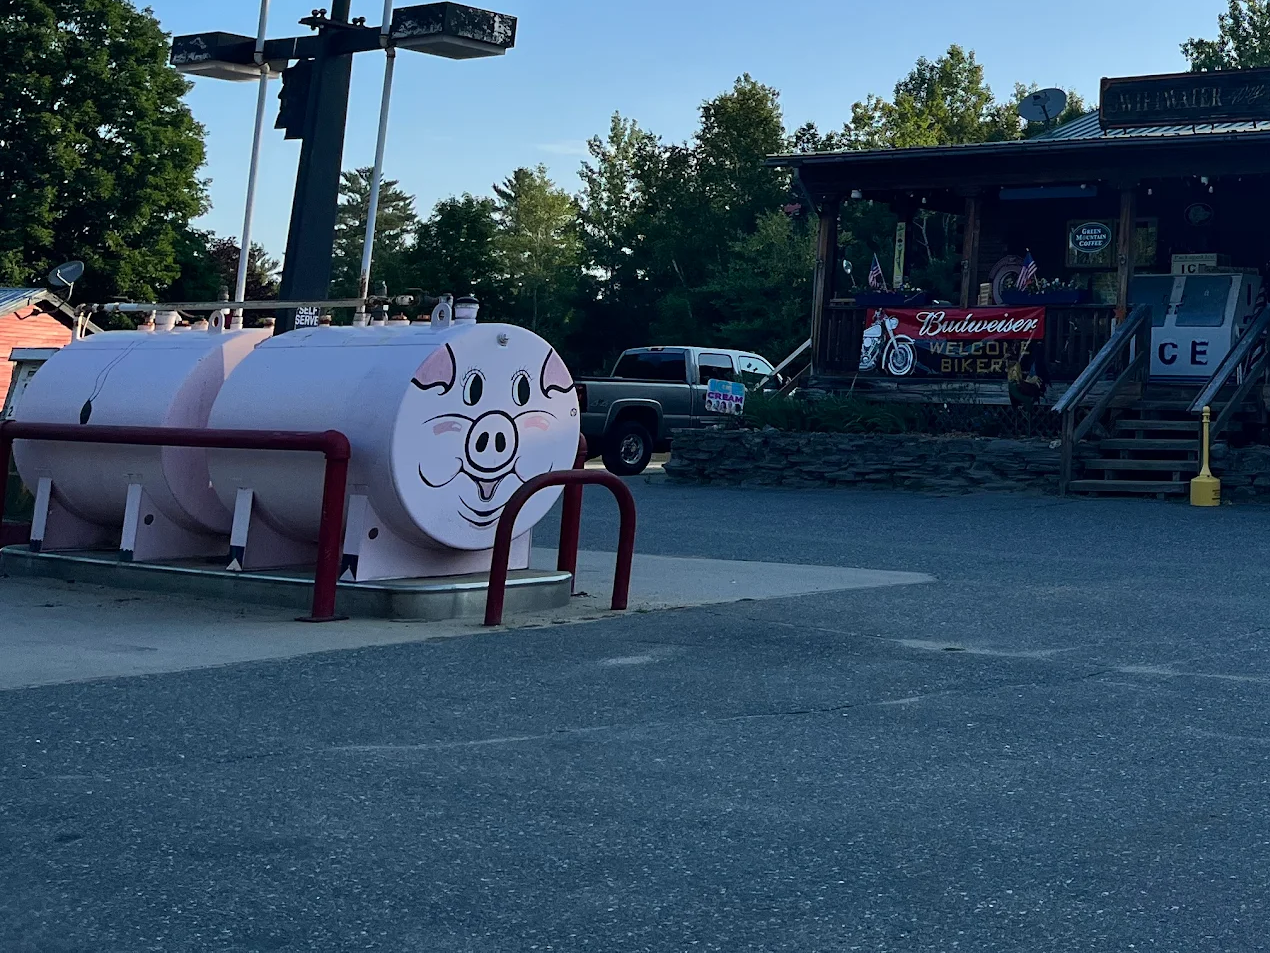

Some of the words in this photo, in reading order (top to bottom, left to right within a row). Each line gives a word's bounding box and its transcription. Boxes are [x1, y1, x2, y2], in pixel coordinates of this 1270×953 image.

[1181, 263, 1206, 274] IC
[299, 307, 319, 315] SELF
[295, 315, 319, 325] SERVE
[916, 311, 1038, 336] Budweiser
[709, 380, 744, 396] ICE
[707, 392, 743, 403] CREAM
